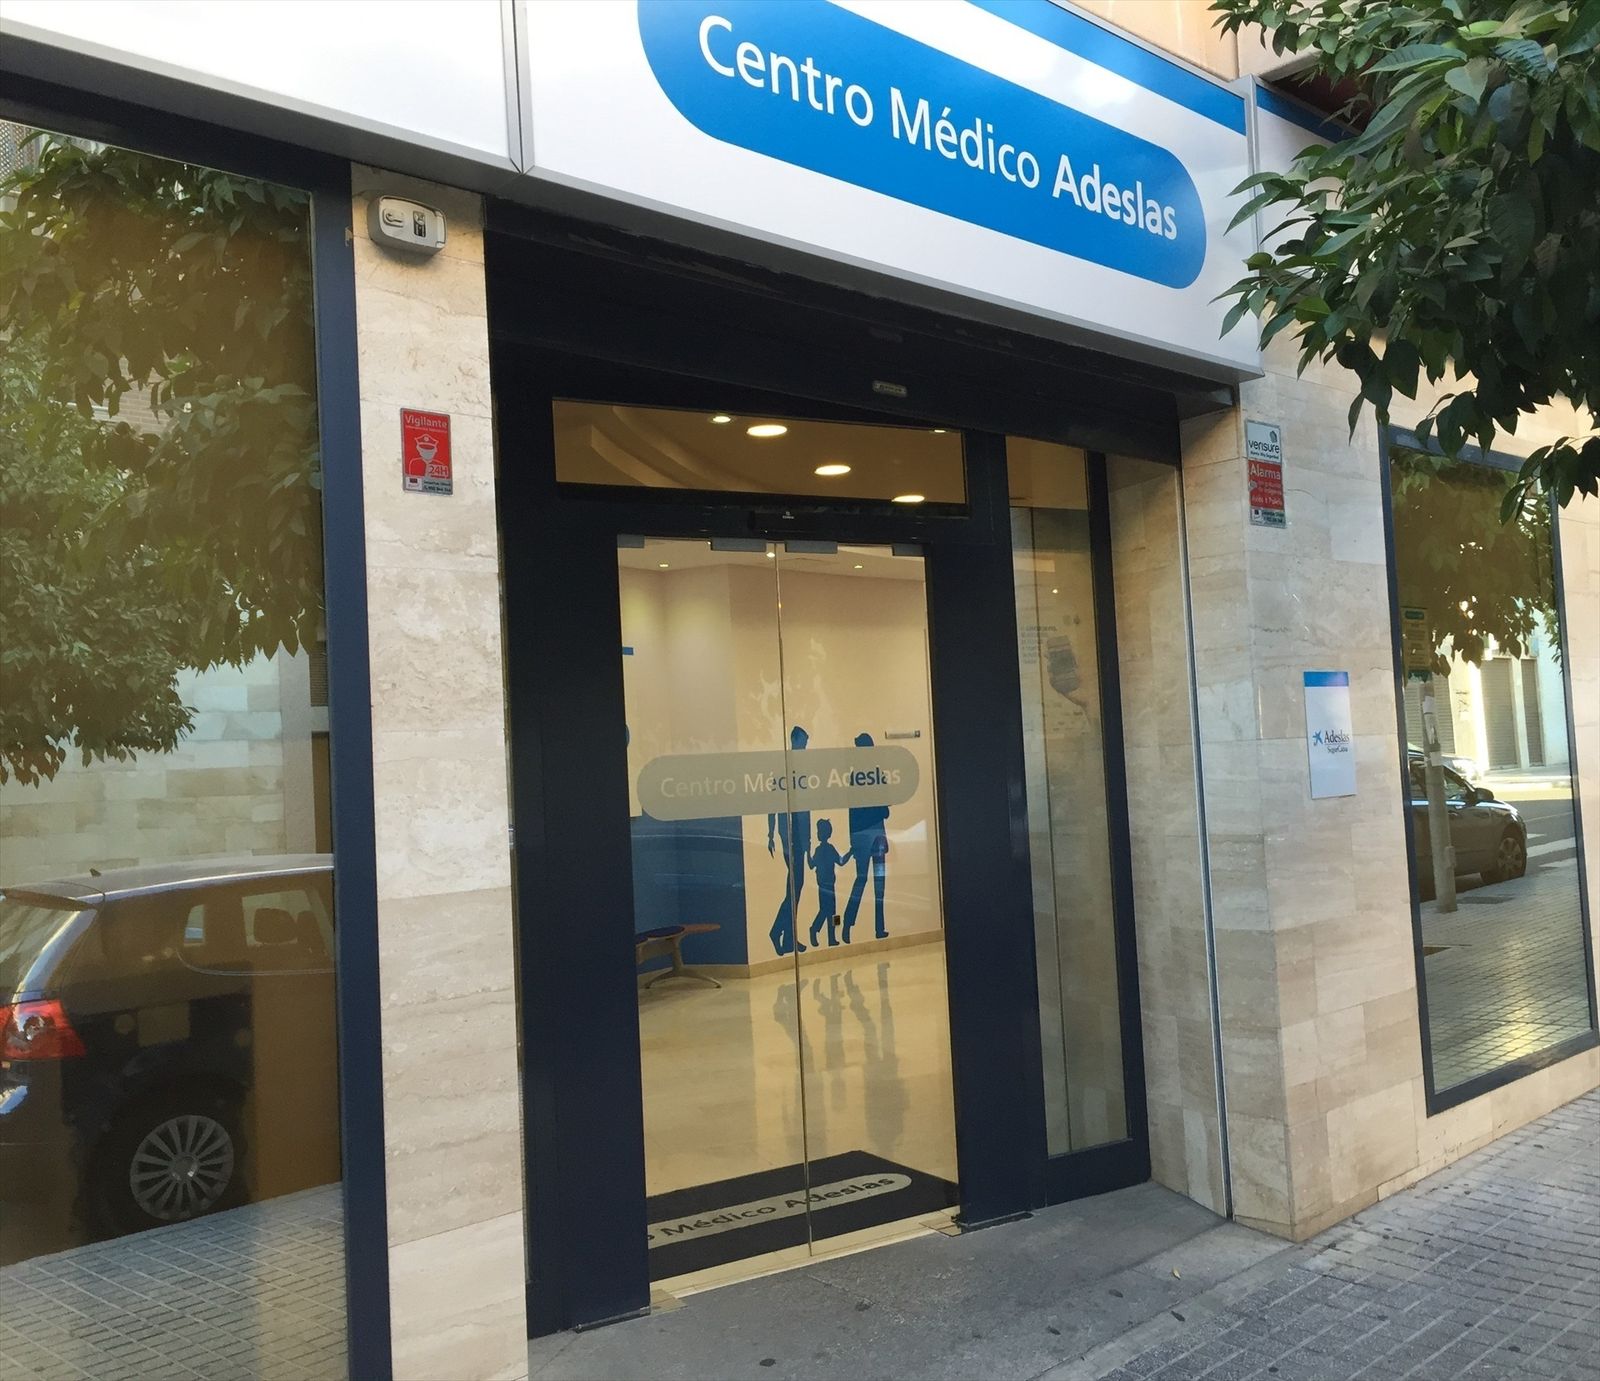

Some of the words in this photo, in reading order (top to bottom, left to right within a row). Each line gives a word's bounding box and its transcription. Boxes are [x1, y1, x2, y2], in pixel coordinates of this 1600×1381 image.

[698, 15, 874, 127] Centro
[890, 86, 1041, 189] Médico
[1051, 153, 1178, 241] Adeslas
[404, 414, 448, 429] Vigilante
[1248, 439, 1280, 454] verisure
[1250, 463, 1281, 480] Alarma
[1324, 729, 1350, 743] Adeslas
[660, 777, 736, 799] Centro
[744, 771, 820, 794] Médico
[826, 766, 900, 789] Adeslas
[660, 1205, 777, 1237] Médico
[784, 1176, 895, 1209] Adeslas
